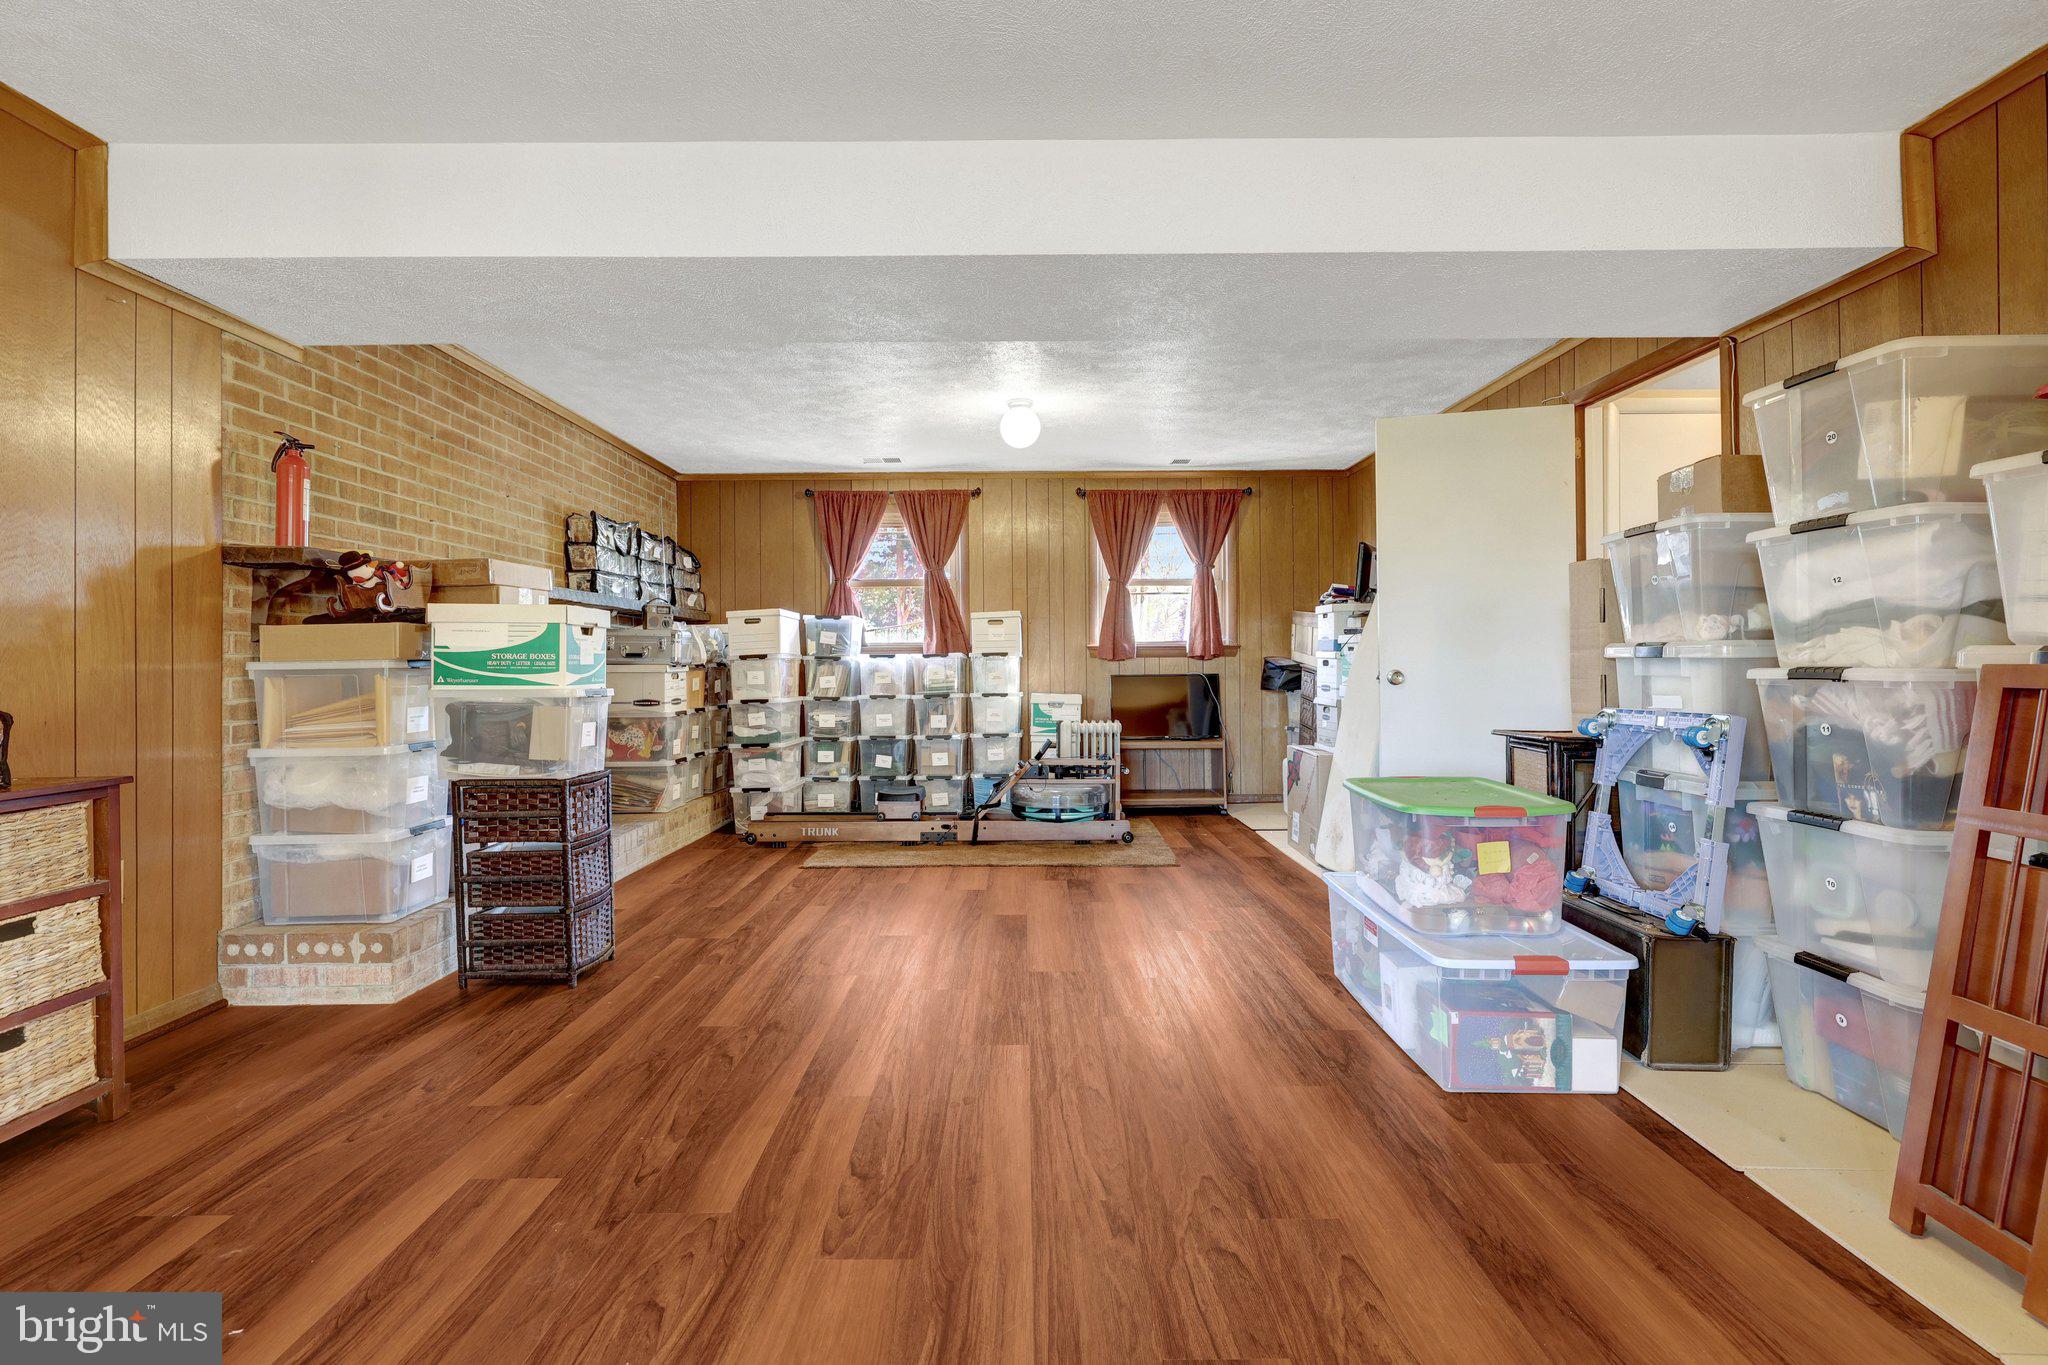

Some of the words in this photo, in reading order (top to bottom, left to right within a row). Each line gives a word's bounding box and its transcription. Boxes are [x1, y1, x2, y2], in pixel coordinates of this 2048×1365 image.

[1827, 433, 1837, 441] 20
[801, 827, 839, 836] TRUNK
[1826, 880, 1836, 888] 10
